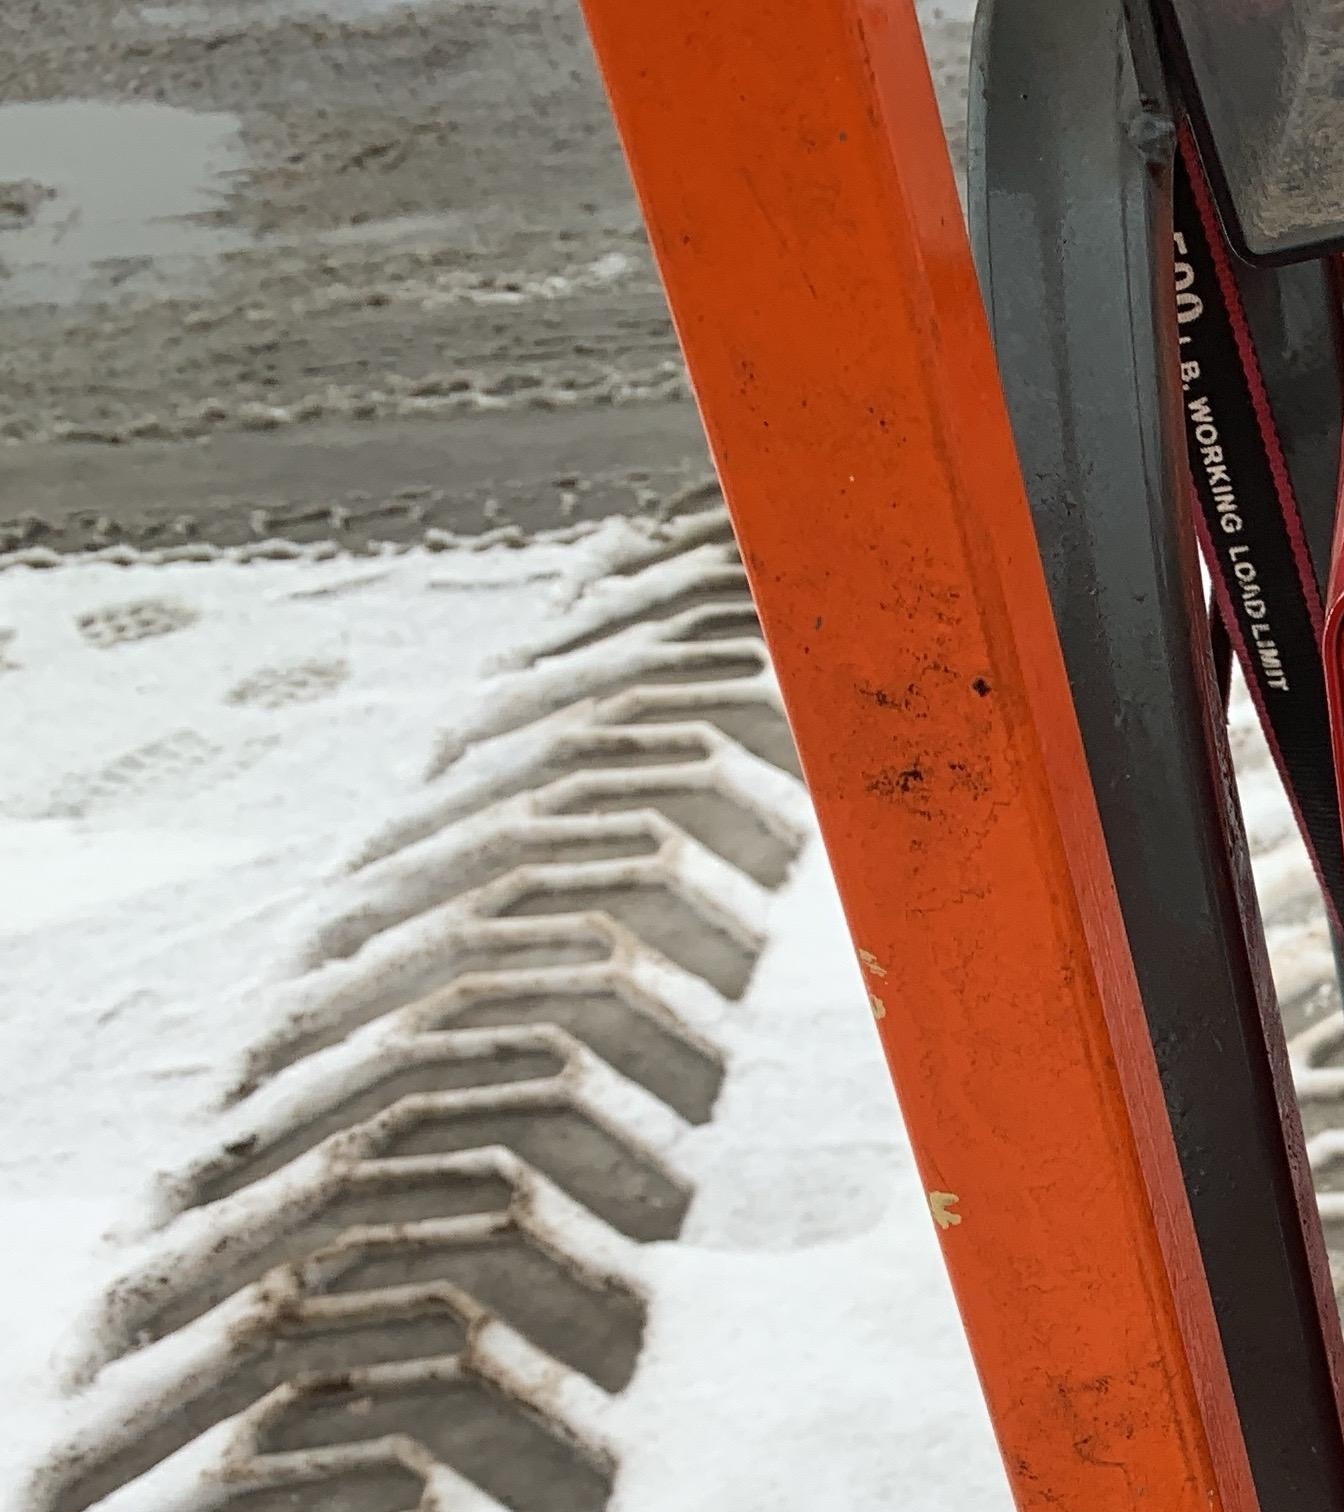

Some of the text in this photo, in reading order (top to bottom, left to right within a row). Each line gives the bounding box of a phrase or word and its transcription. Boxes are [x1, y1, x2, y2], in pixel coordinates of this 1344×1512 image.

[1188, 396, 1243, 534] WORKING
[1228, 545, 1267, 620] LOAD
[1250, 622, 1290, 692] LIMIT
